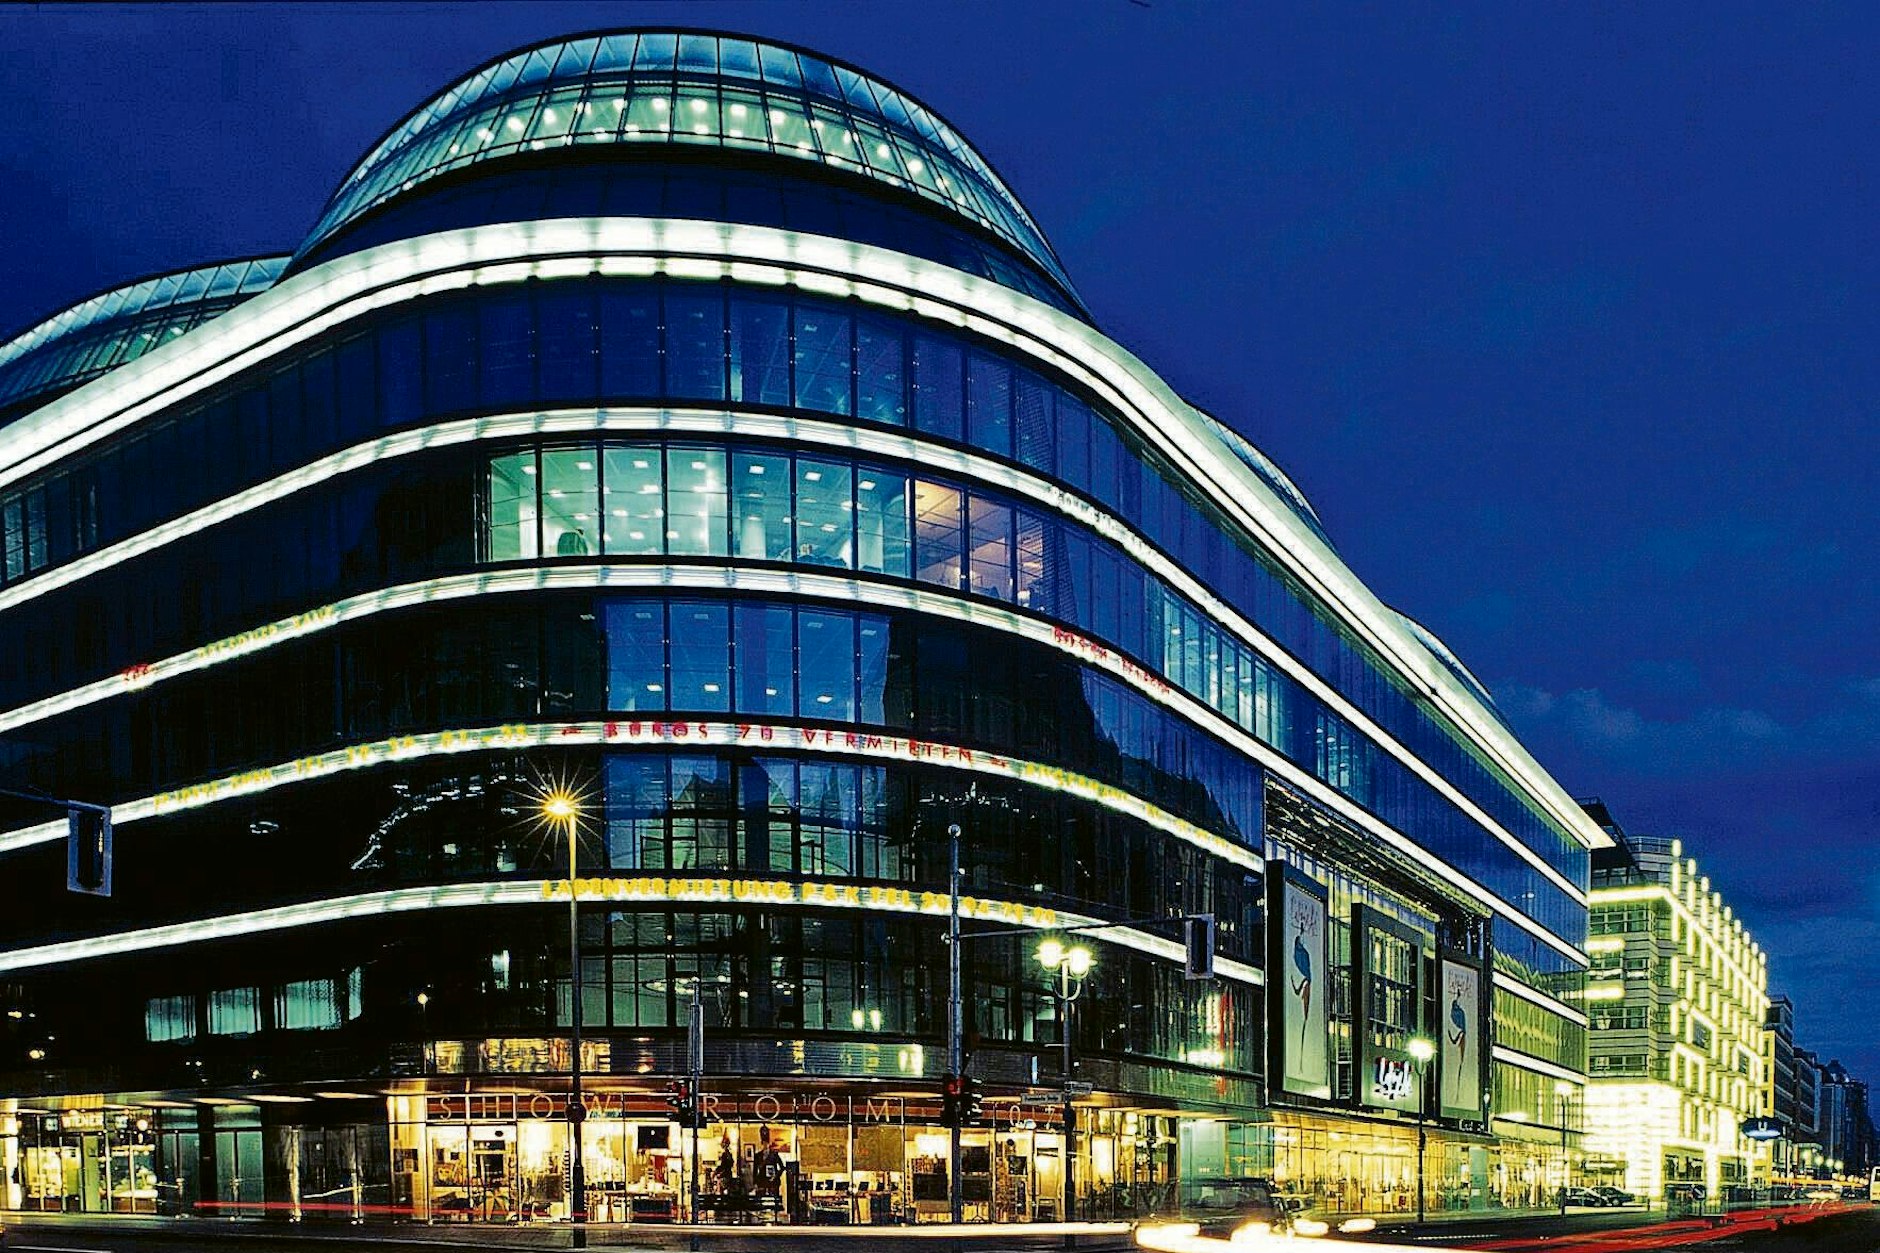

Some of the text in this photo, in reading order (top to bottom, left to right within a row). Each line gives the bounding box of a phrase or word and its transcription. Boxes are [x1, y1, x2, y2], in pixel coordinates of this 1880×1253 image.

[439, 1094, 612, 1121] SHOW
[702, 1094, 890, 1122] ROOM
[1757, 1120, 1768, 1132] U
